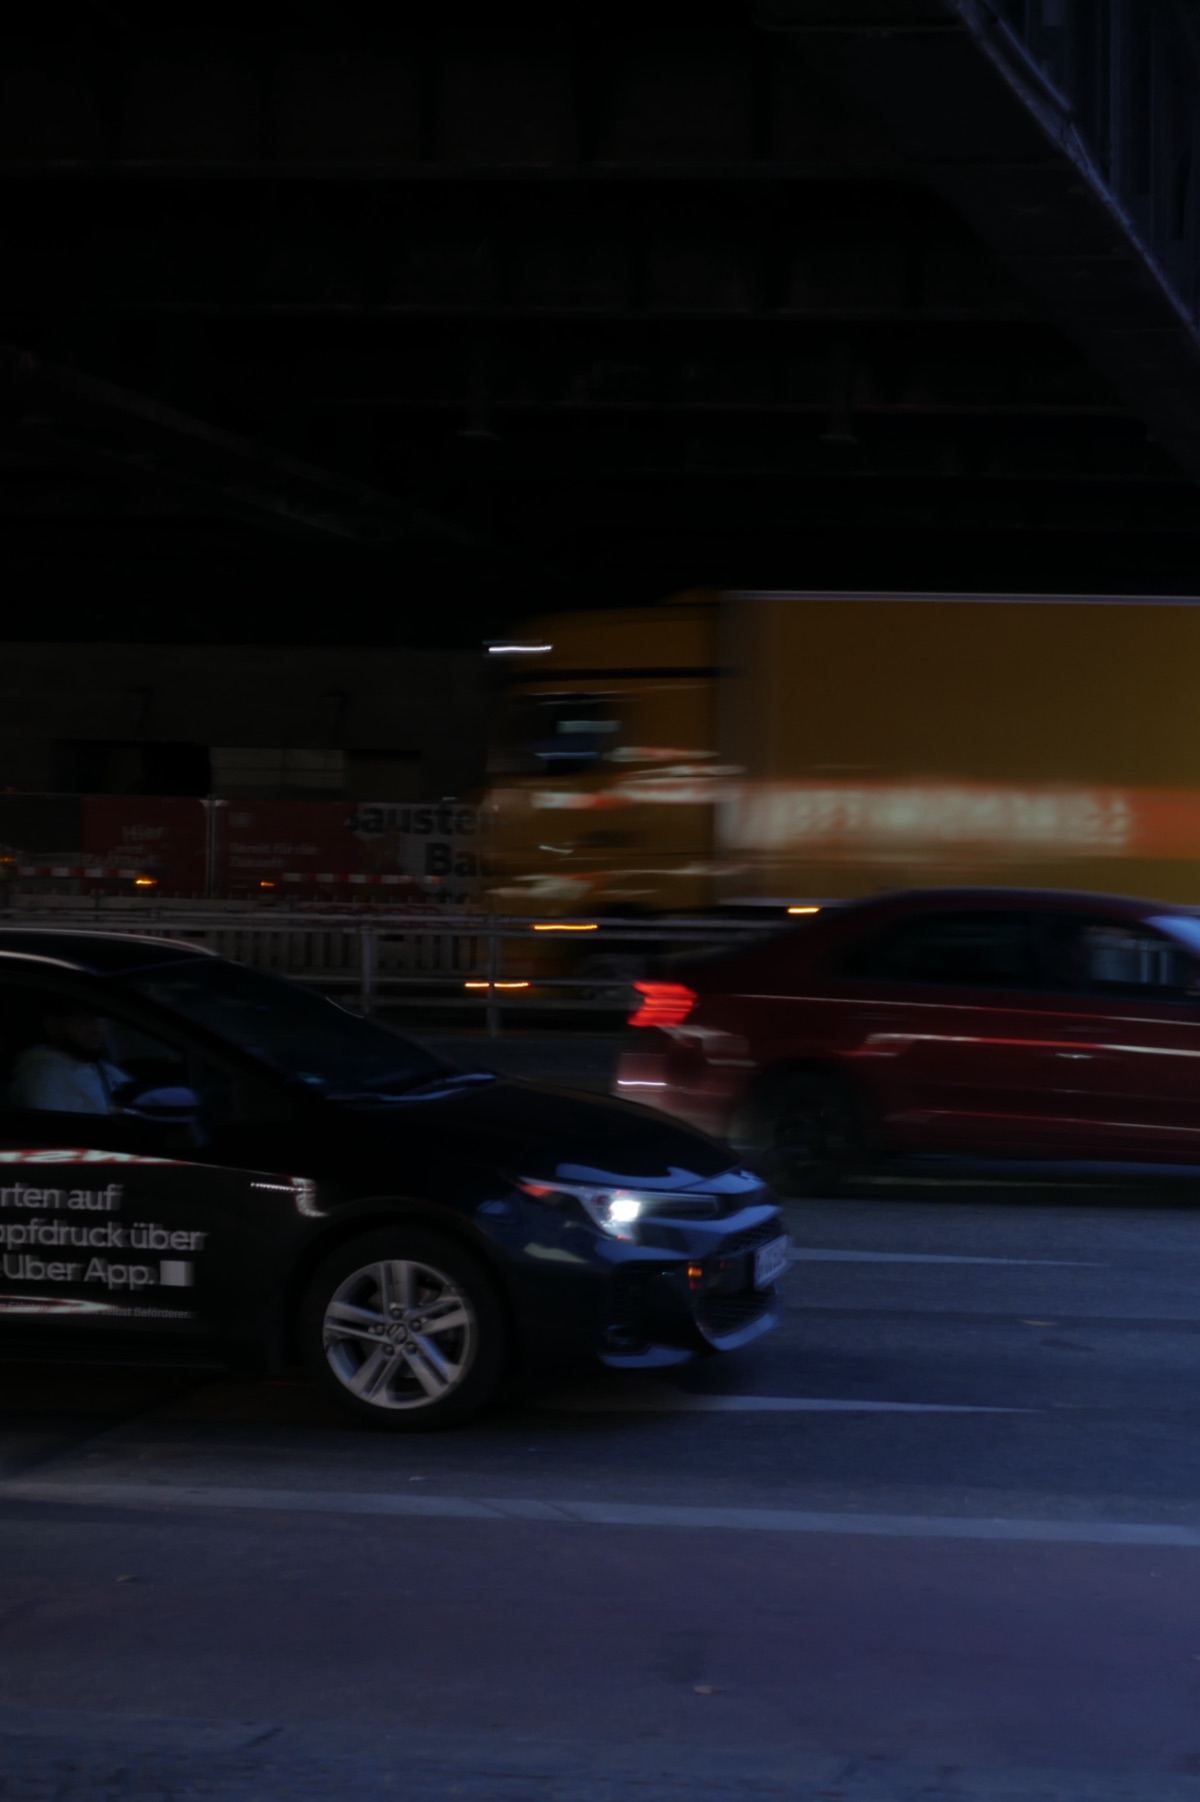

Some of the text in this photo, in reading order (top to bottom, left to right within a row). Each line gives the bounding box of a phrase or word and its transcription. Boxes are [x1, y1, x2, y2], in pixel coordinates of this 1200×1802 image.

[67, 1185, 123, 1211] auf
[129, 1222, 208, 1251] über
[2, 1253, 156, 1291] Uber App.
